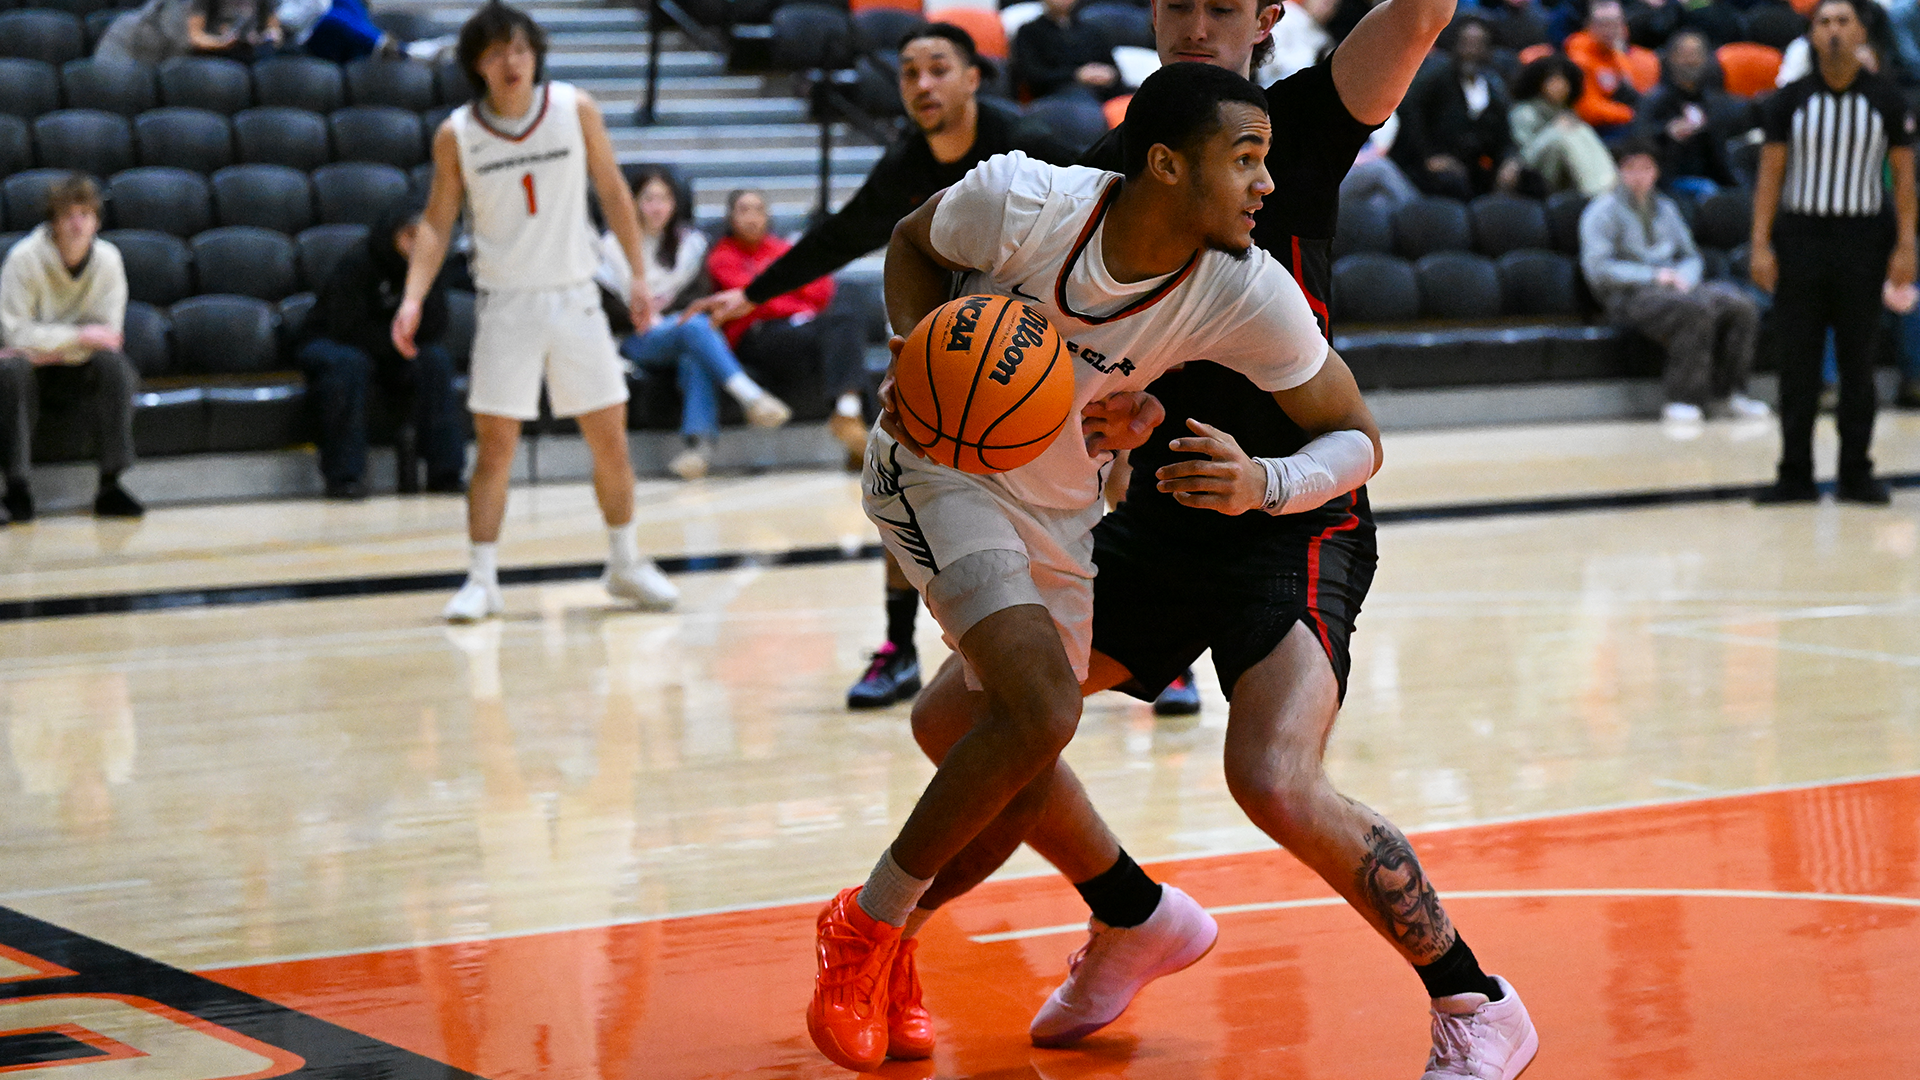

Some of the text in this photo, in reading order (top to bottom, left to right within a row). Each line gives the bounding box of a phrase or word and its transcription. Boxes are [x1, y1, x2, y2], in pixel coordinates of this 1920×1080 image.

[522, 173, 537, 216] 1
[946, 296, 993, 351] NCAA
[988, 304, 1048, 385] Wilson
